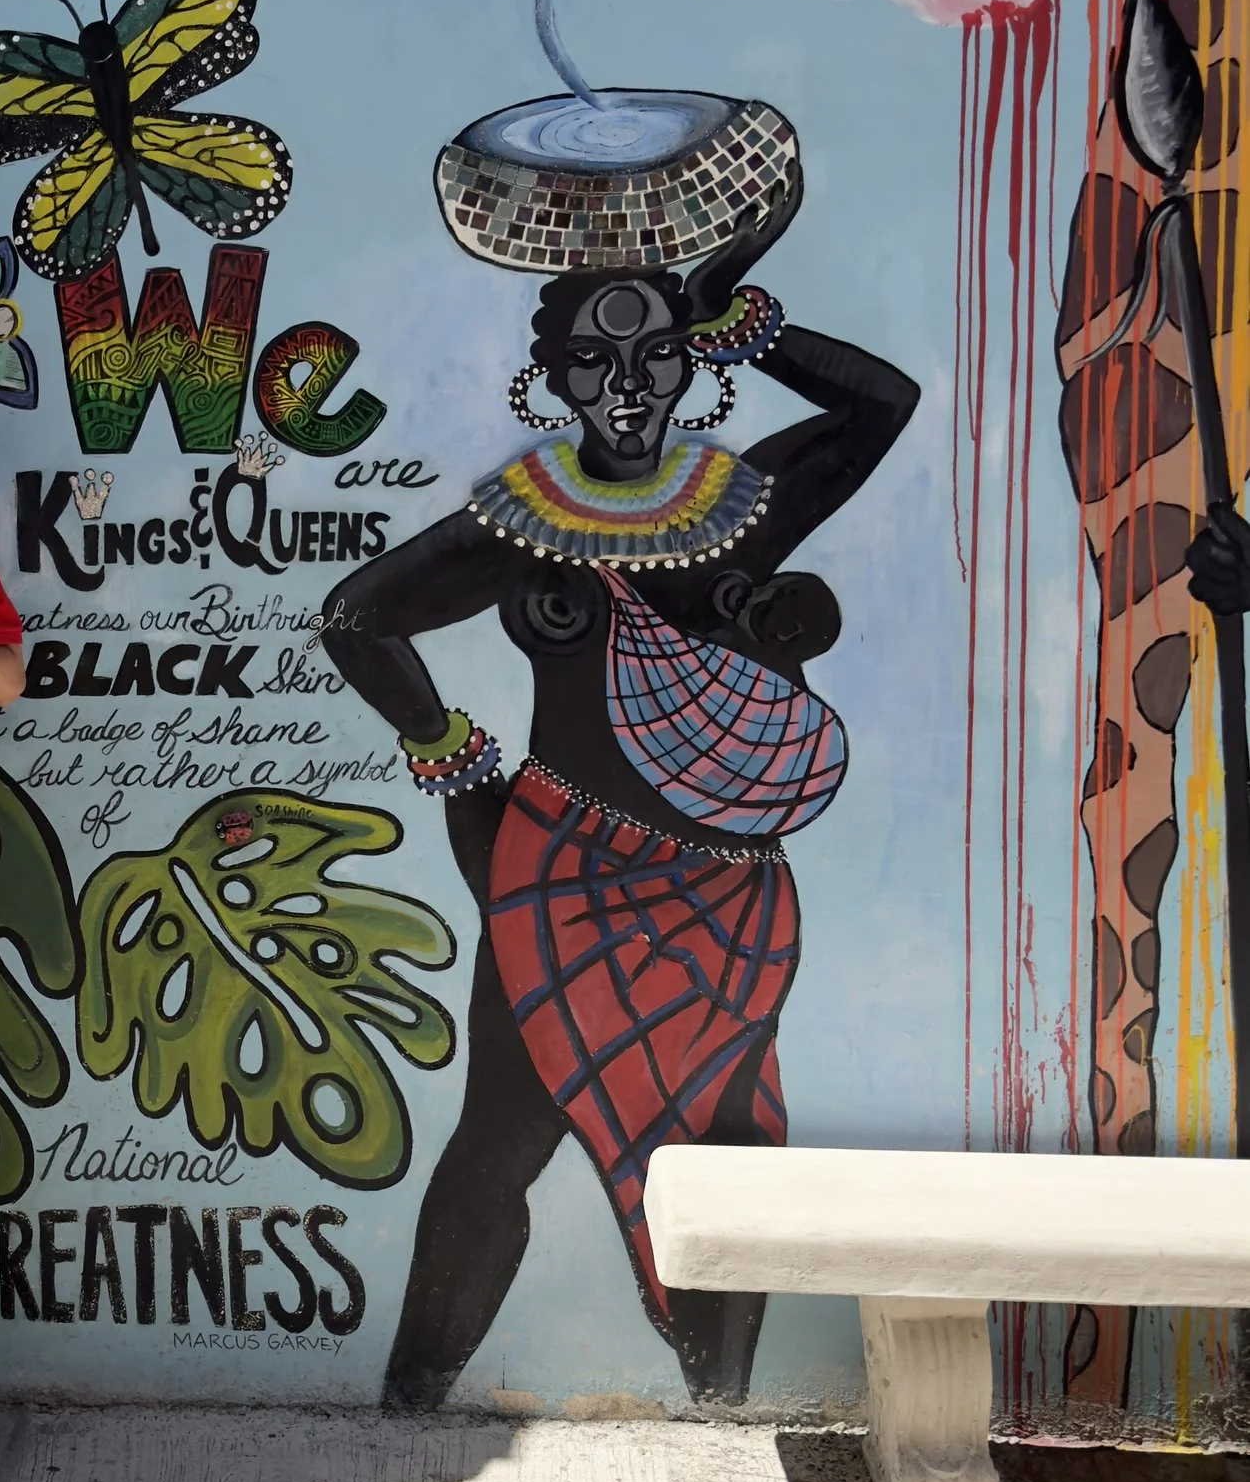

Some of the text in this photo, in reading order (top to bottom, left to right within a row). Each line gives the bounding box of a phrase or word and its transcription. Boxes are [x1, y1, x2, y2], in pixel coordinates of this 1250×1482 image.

[54, 243, 387, 455] We
[335, 458, 439, 489] are
[16, 470, 192, 591] KINGS
[212, 462, 390, 575] QUEENS
[21, 640, 260, 699] BLACK
[13, 719, 49, 742] a
[48, 707, 144, 755] badge
[151, 707, 192, 758] of
[187, 706, 330, 745] shame
[17, 749, 399, 797] but rather a symbol
[81, 790, 131, 849] of
[37, 1123, 246, 1186] National
[173, 1332, 343, 1357] MARCUS GARVEY
